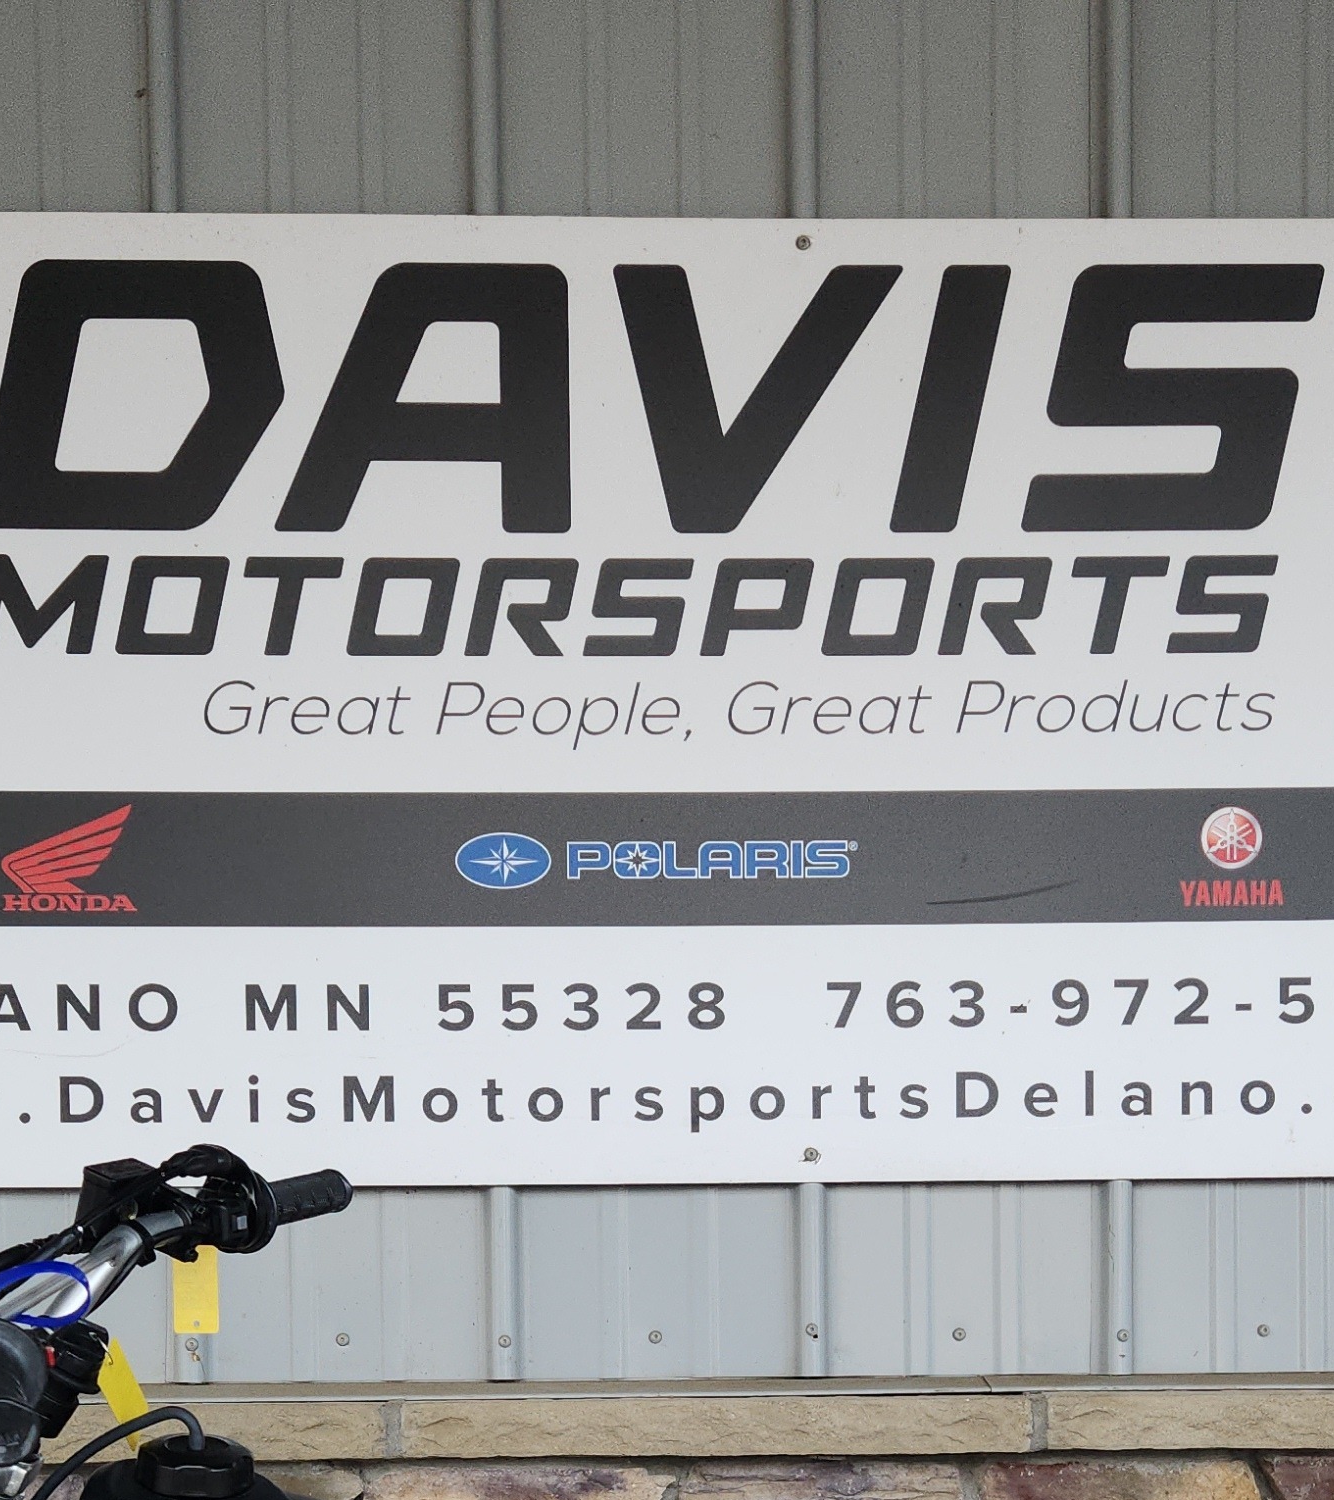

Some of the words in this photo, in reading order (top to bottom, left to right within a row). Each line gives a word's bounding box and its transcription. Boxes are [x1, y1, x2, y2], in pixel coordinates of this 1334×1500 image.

[203, 681, 411, 736] Great
[435, 681, 692, 751] People,
[727, 680, 933, 735] Great
[956, 679, 1276, 734] Products
[2, 894, 138, 912] HONDA
[1181, 880, 1284, 906] YAMAHA
[245, 984, 370, 1031] MN
[438, 982, 725, 1031] 55328
